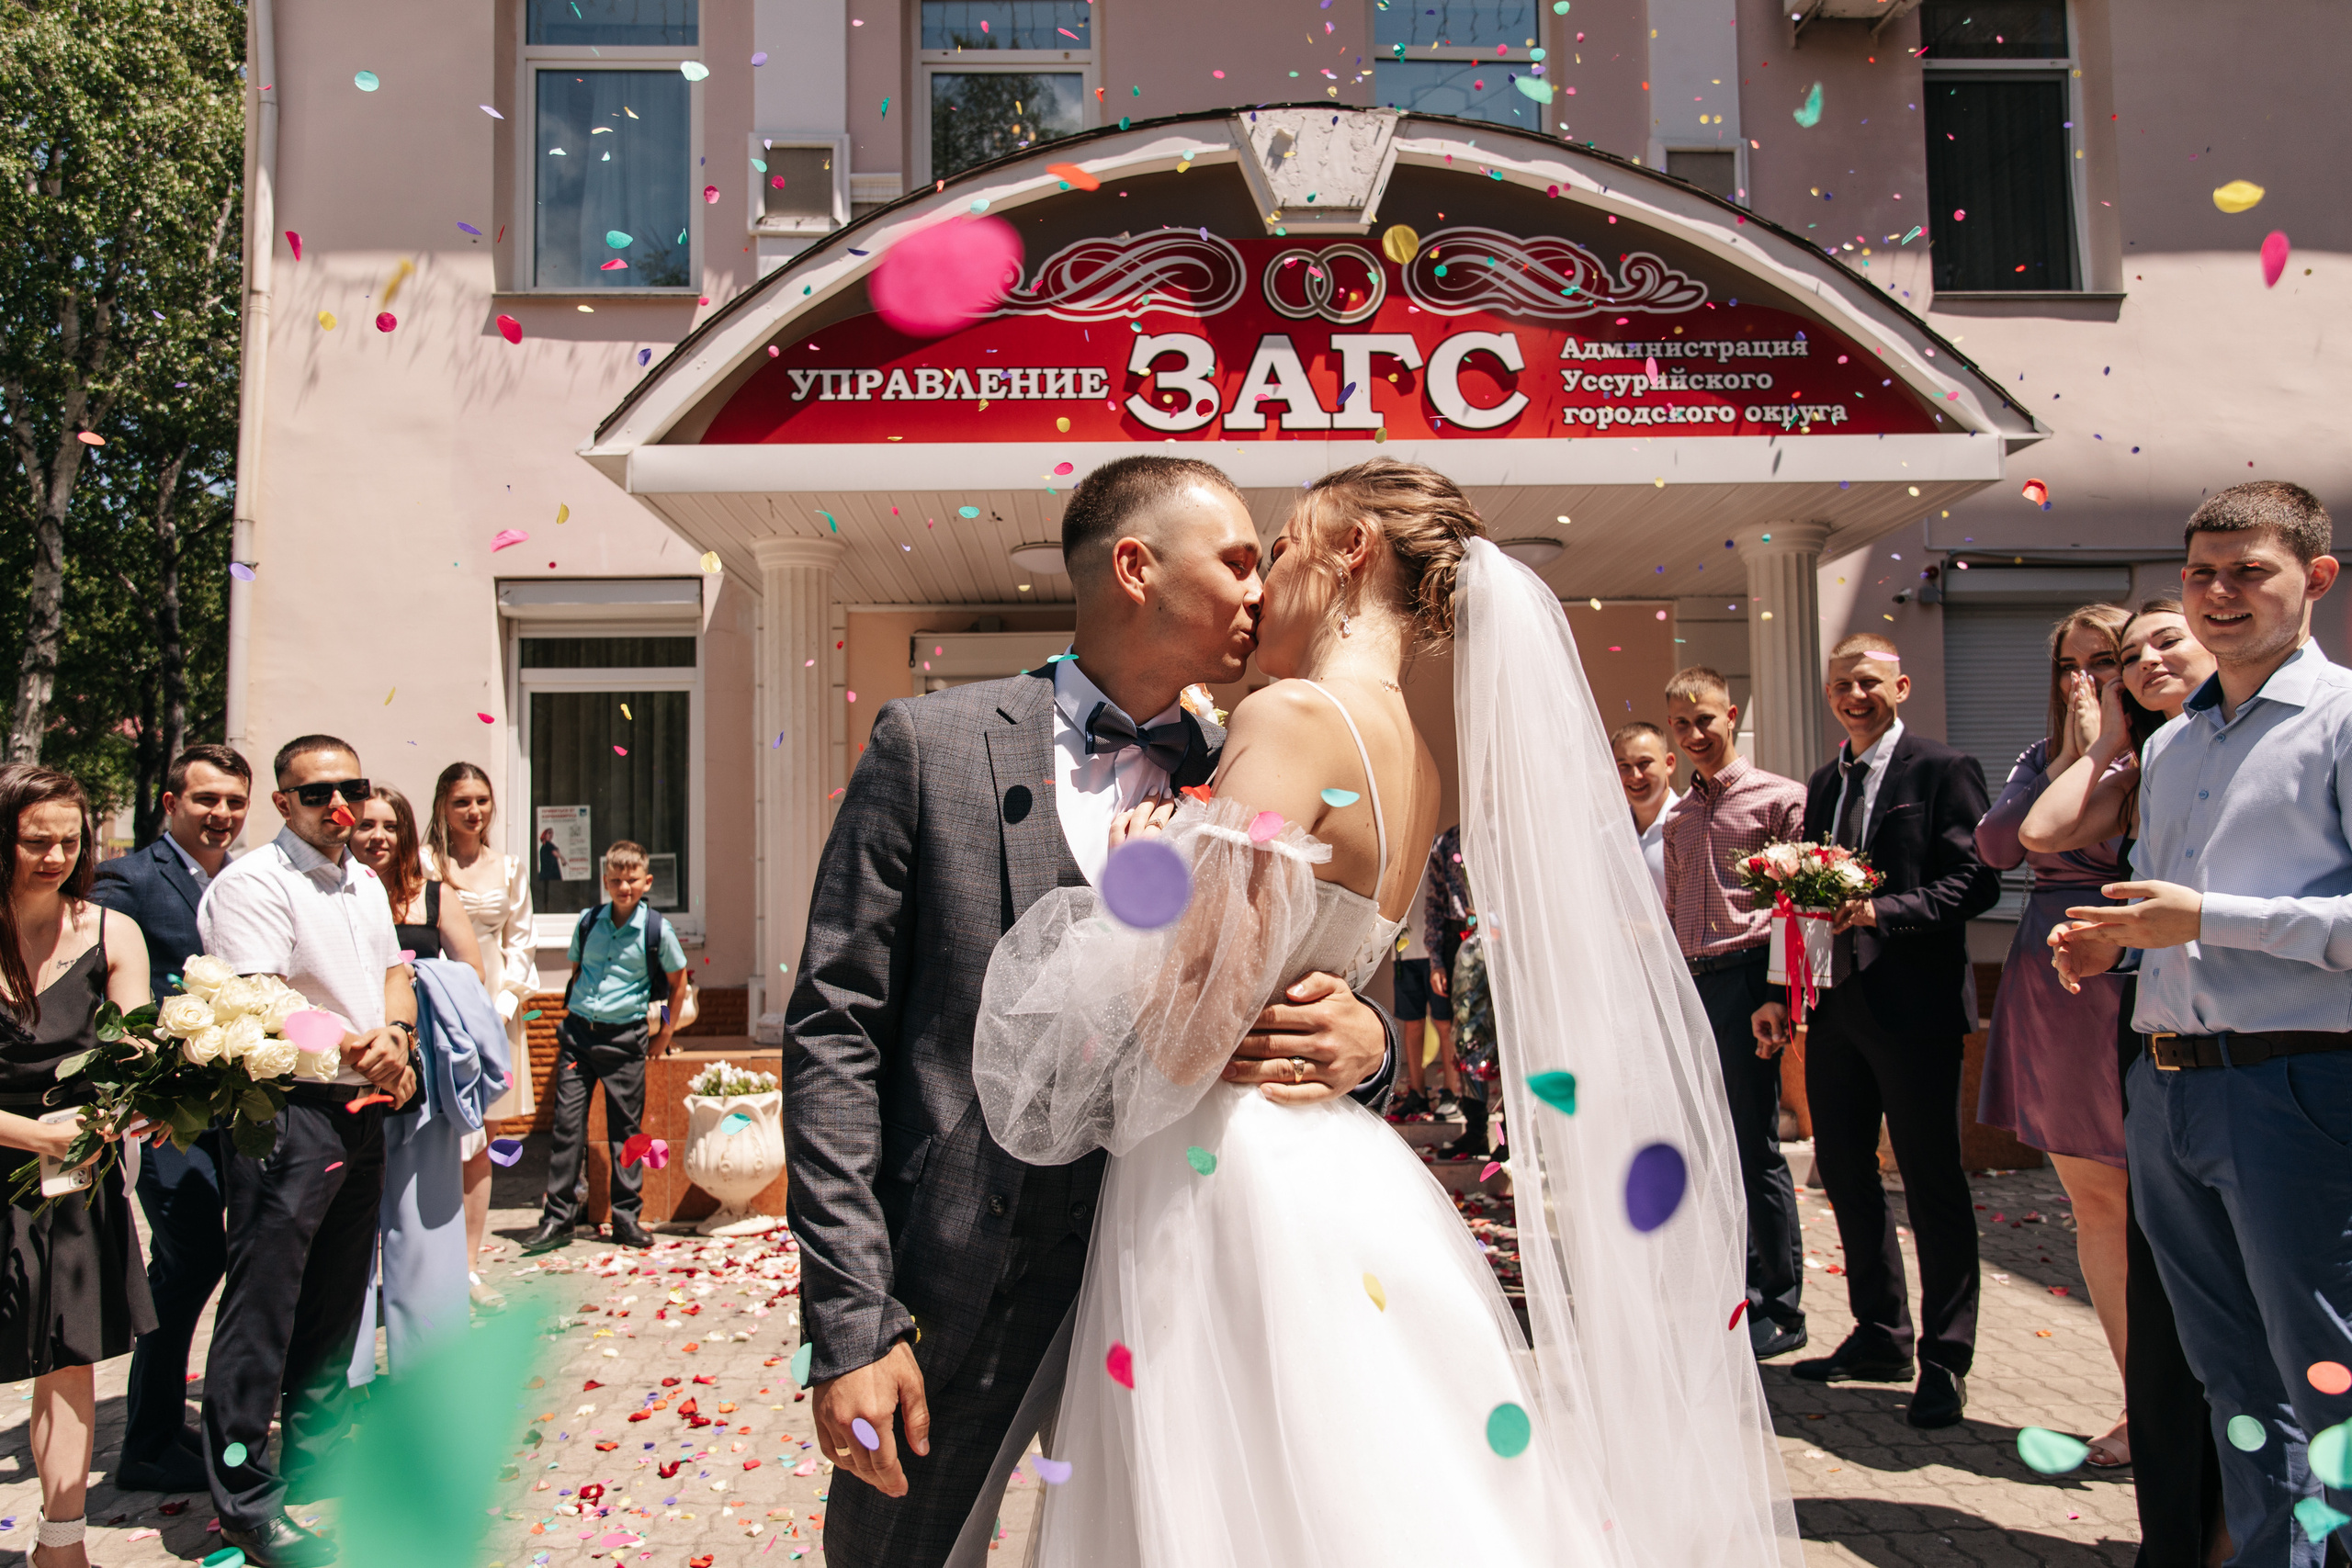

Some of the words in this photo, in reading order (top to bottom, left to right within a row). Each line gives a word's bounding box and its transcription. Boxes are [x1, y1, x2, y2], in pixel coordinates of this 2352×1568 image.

[1560, 336, 1808, 362] Администрация
[786, 367, 1110, 401] УПРАВЛЕНИЕ
[1125, 332, 1530, 431] ЗАГС
[1561, 367, 1773, 397] Уссурийского
[1563, 405, 1736, 430] городского
[1745, 404, 1849, 428] округа
